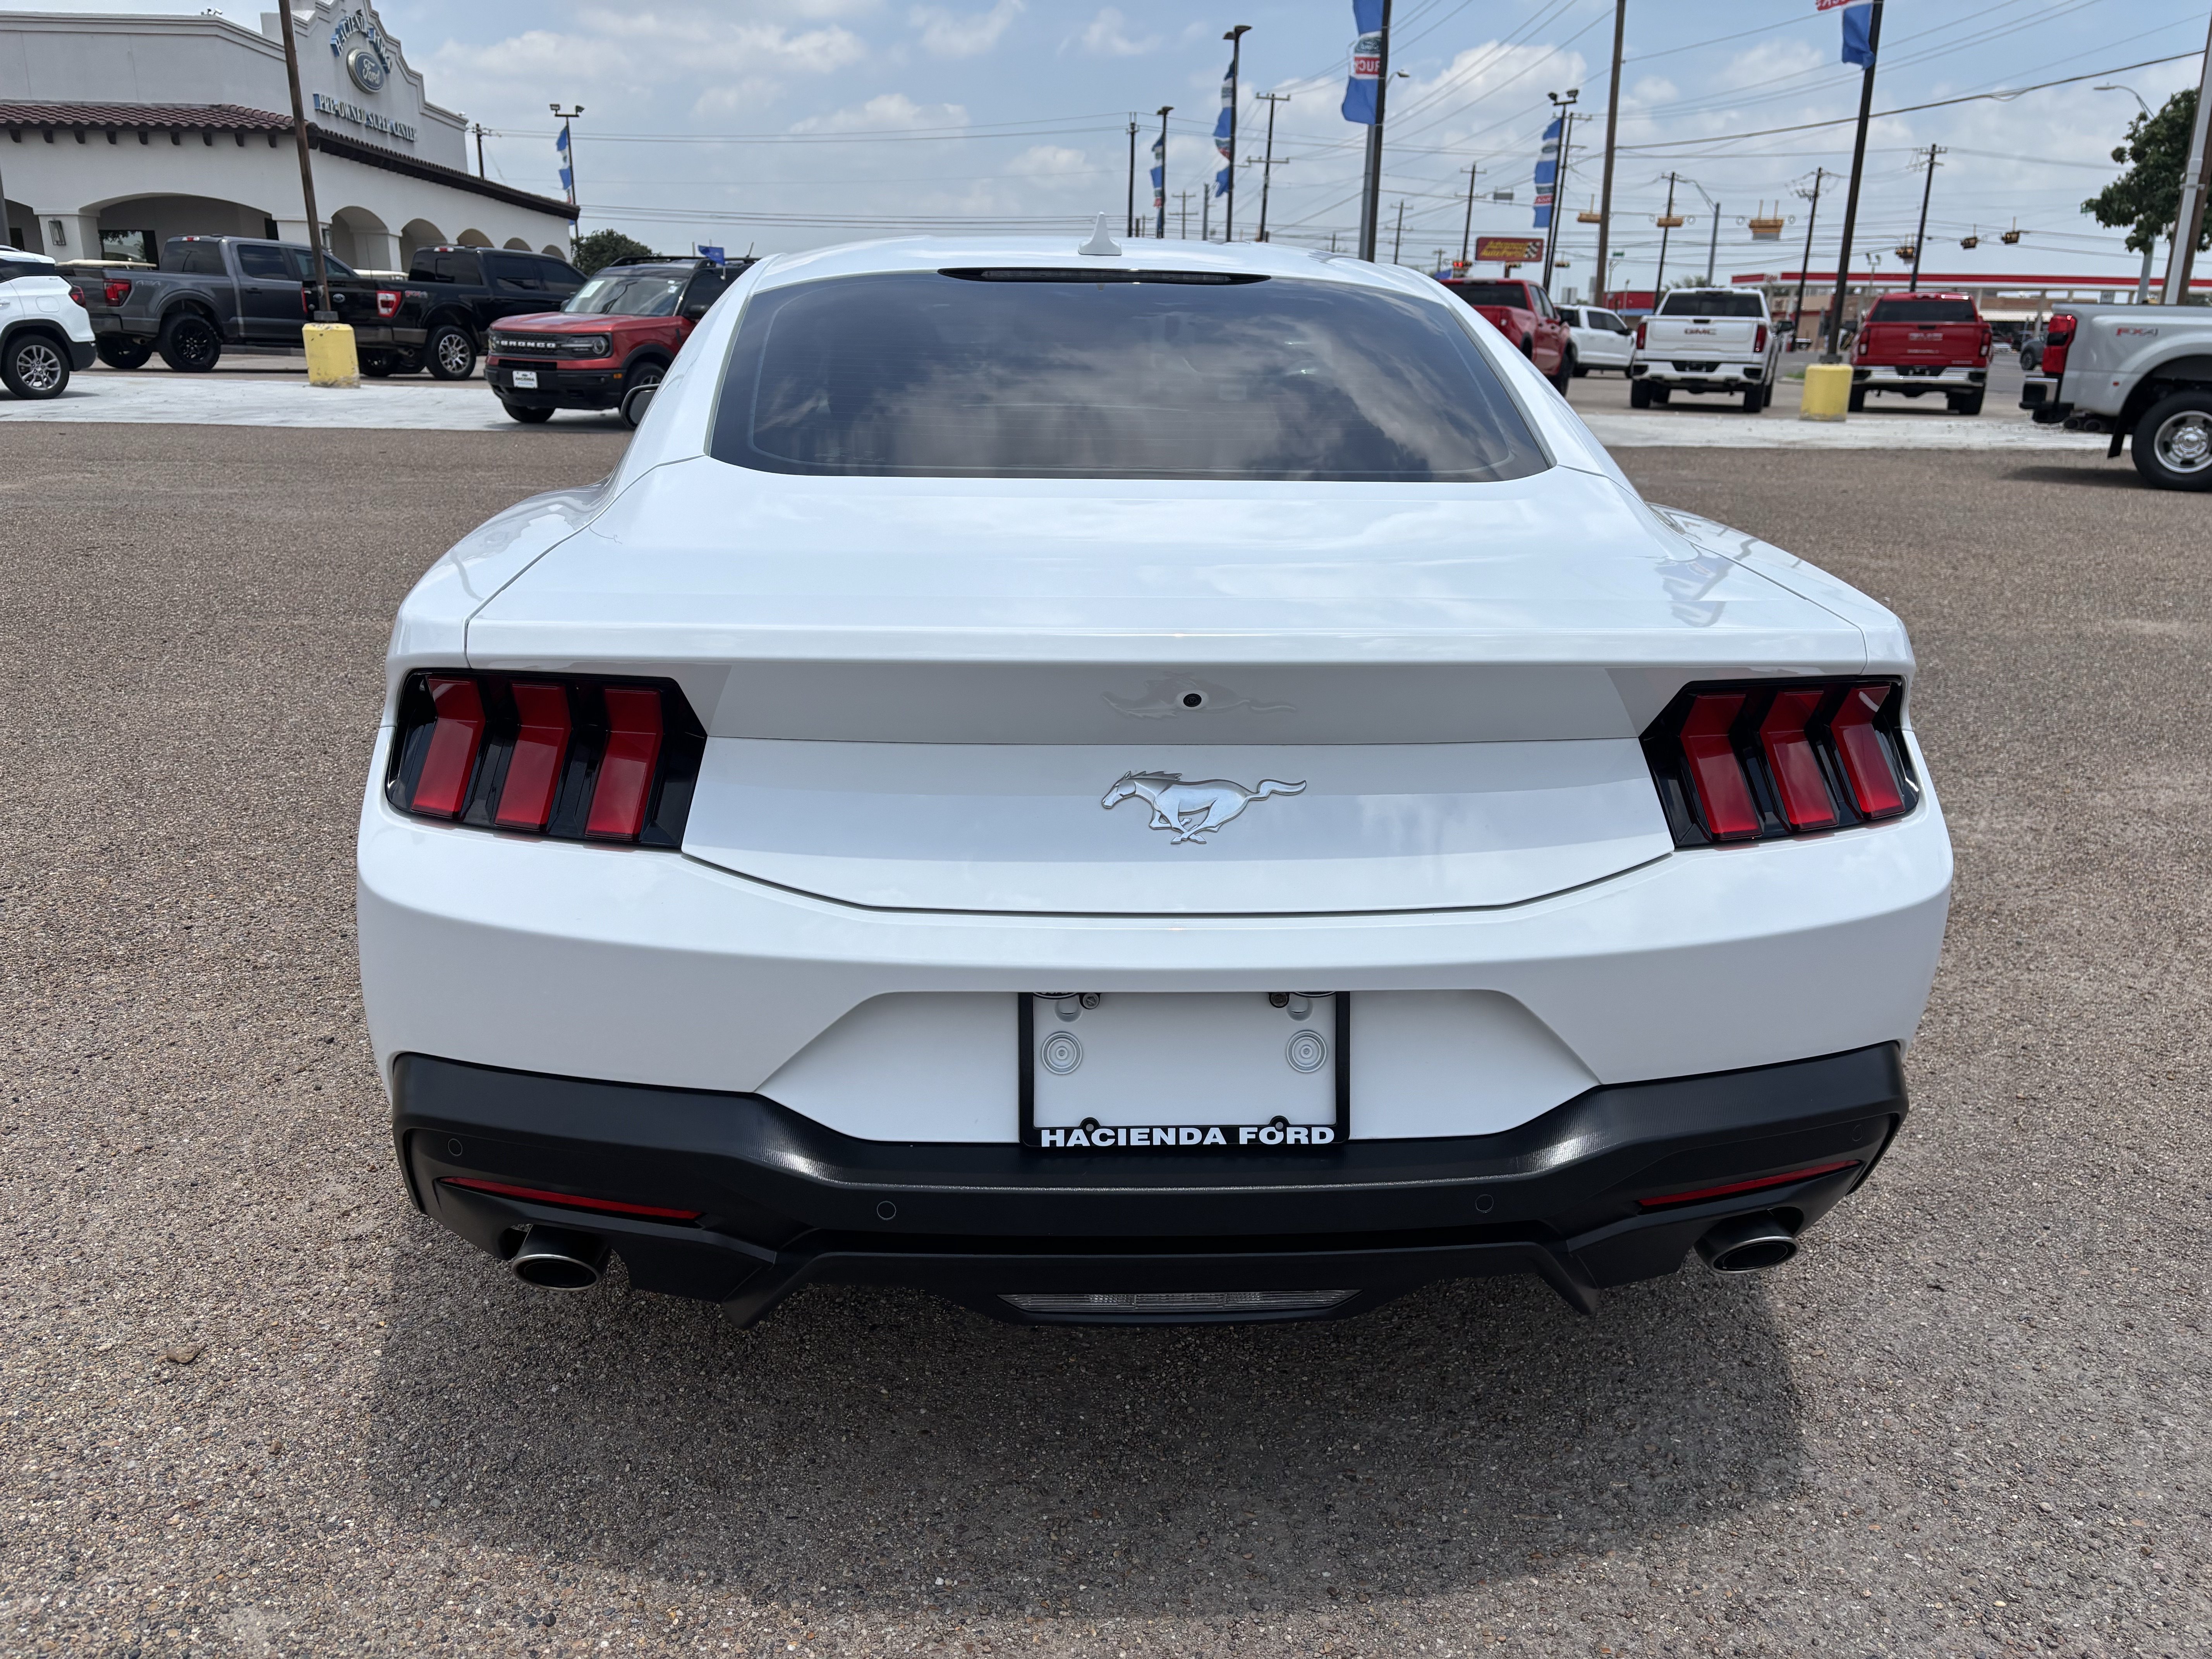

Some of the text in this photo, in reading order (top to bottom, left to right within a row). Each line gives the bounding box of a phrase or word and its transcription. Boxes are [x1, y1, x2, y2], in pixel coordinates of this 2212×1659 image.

[331, 14, 368, 57] HACIEN
[362, 58, 380, 84] Ford
[315, 94, 366, 124] PRE-OWNED
[368, 112, 389, 132] SUPER
[501, 340, 556, 348] BRONCO
[1041, 1127, 1334, 1147] HACIENDA FORD
